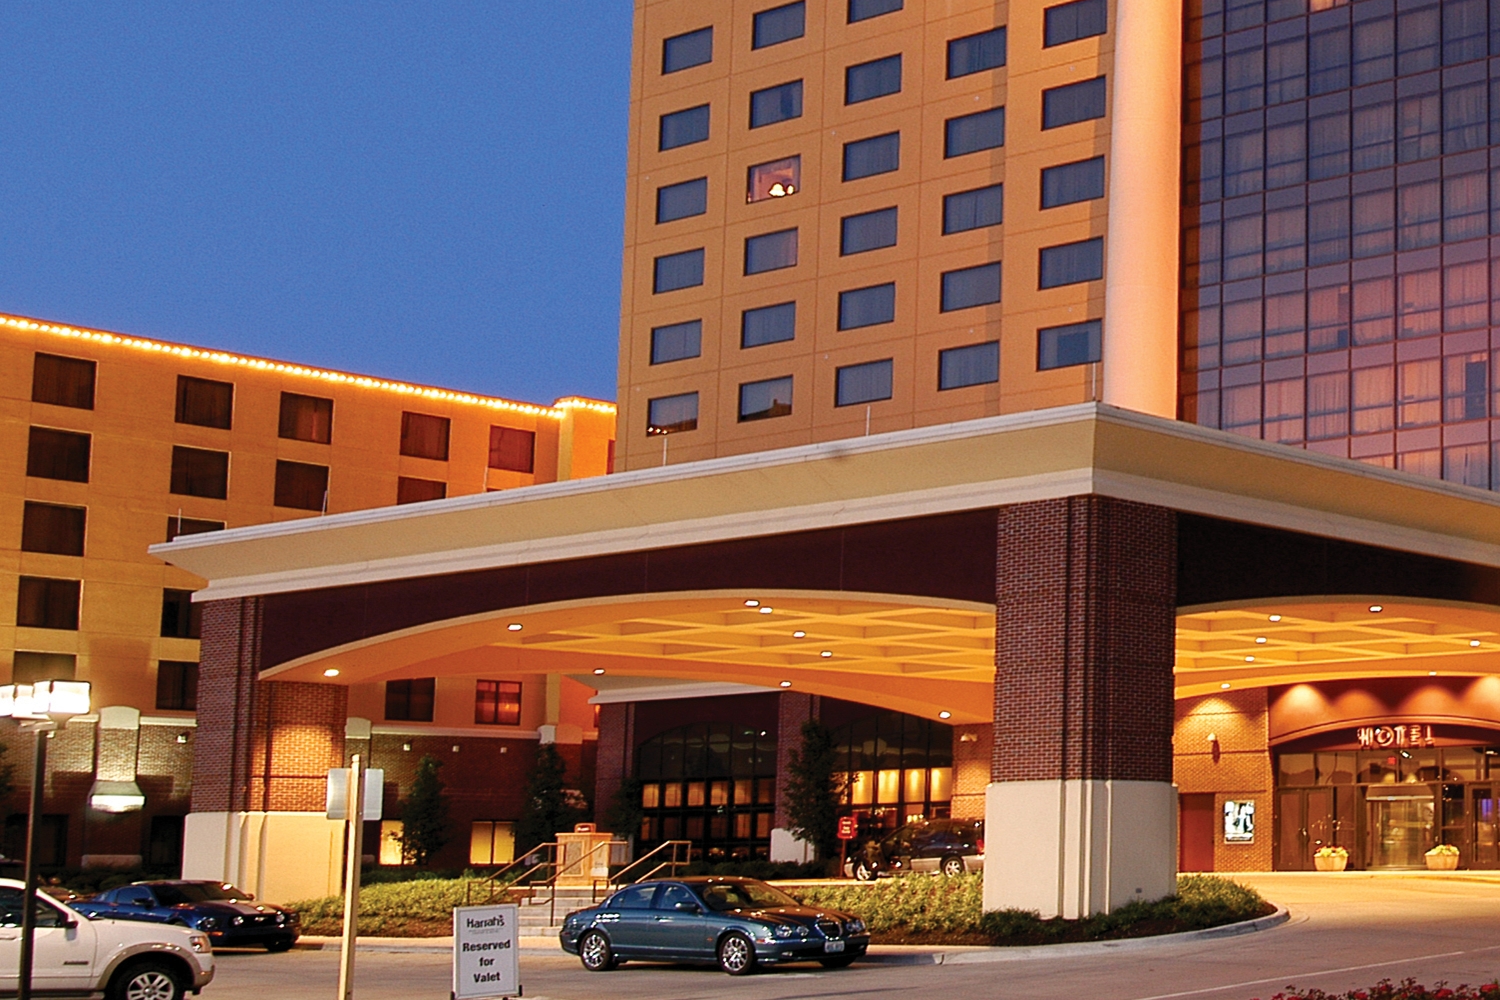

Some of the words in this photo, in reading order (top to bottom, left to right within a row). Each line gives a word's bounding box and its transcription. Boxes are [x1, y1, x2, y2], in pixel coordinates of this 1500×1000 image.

[1357, 725, 1435, 747] HOTEL
[462, 939, 511, 952] Reserved
[478, 957, 495, 967] for
[473, 972, 501, 983] Valet
